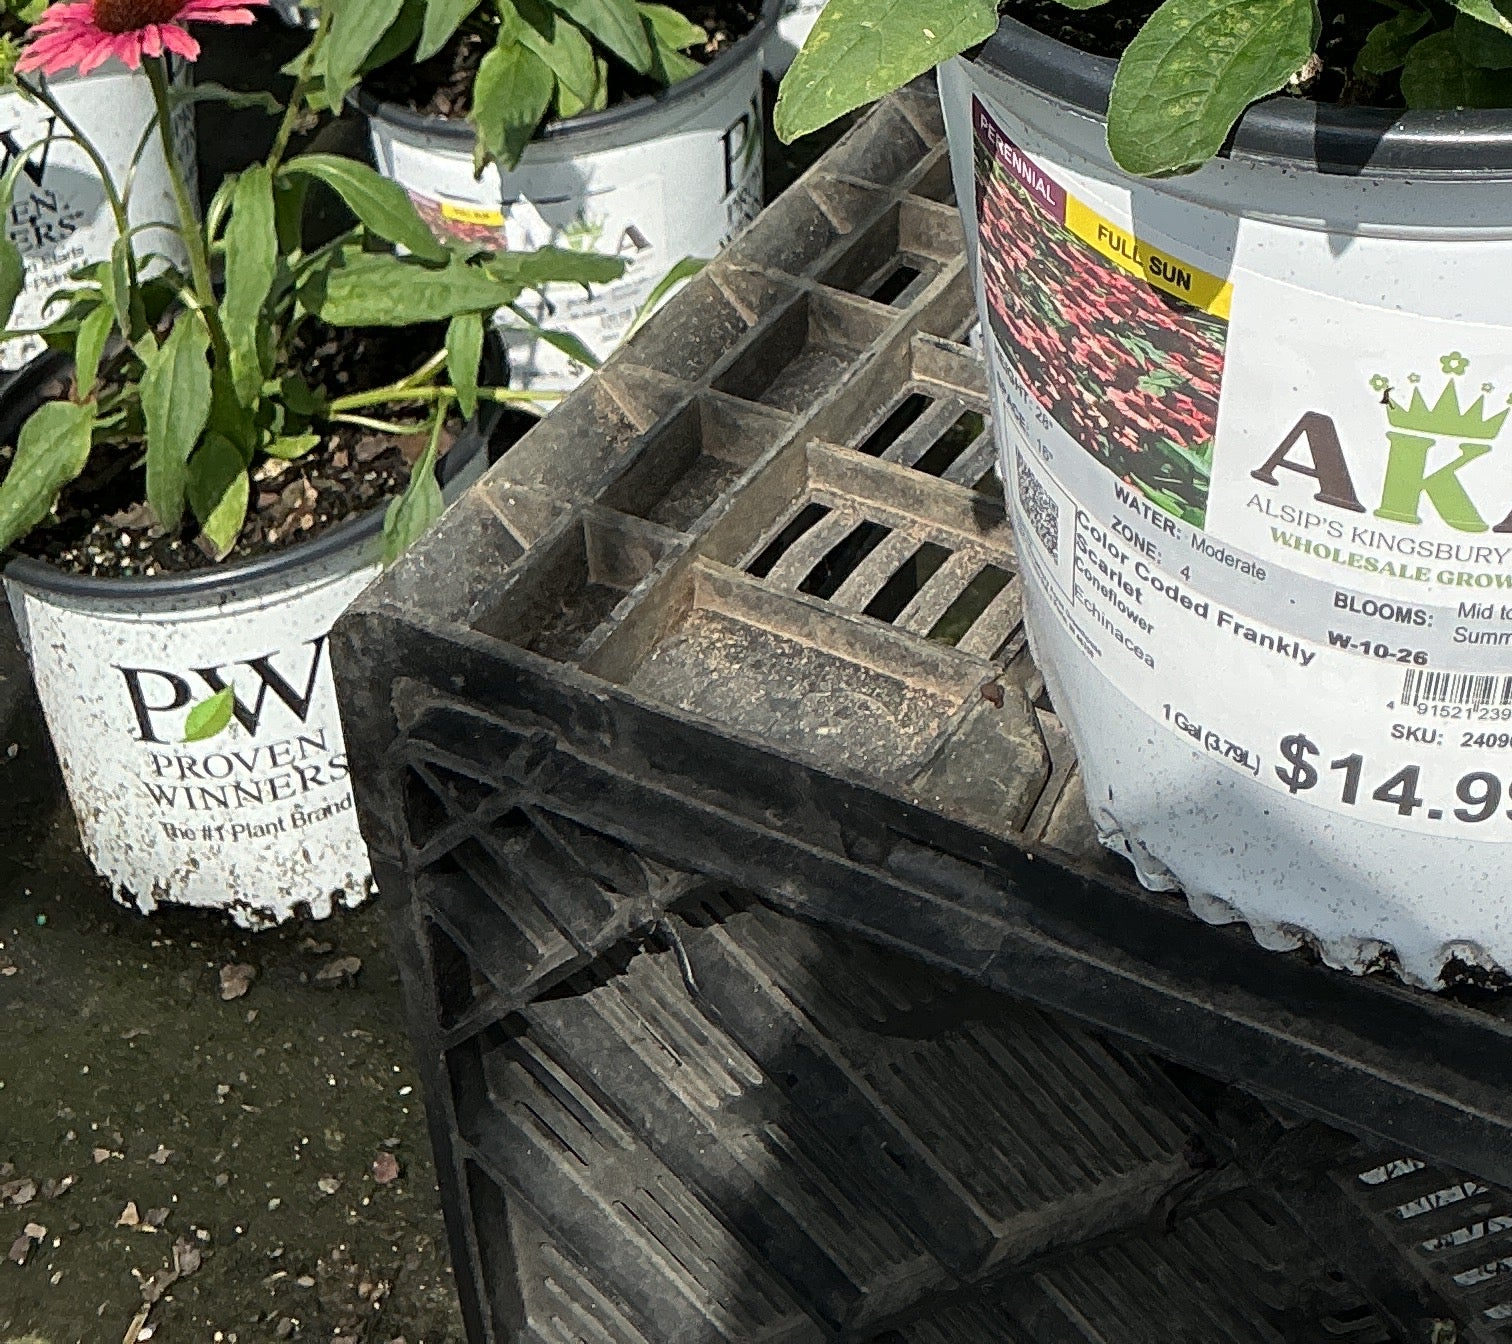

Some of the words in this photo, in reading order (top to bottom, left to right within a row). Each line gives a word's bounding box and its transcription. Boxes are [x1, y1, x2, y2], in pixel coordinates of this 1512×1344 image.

[980, 115, 1056, 206] PERENNIAL
[1097, 223, 1144, 266] FULL
[1149, 255, 1192, 291] SUN
[1111, 514, 1162, 564] ZONE:
[1179, 565, 1191, 582] 4
[1114, 482, 1182, 540] WATER:
[1191, 532, 1267, 582] Moderate
[1246, 493, 1344, 539] ALSIP'S
[1351, 525, 1512, 565] KINGSBURY
[1270, 526, 1430, 583] WHOLESALE
[1075, 555, 1154, 635] Coneflower
[1076, 533, 1143, 604] Scarlet
[1076, 510, 1130, 566] Color
[1134, 560, 1209, 620] Coded
[1216, 609, 1316, 668] Frankly
[1073, 582, 1156, 670] Echinacea
[1333, 591, 1434, 627] BLOOMS:
[1457, 601, 1495, 621] Mid
[1327, 629, 1429, 666] W-10-26
[110, 634, 330, 744] PW
[1162, 703, 1171, 721] 1
[1174, 711, 1202, 742] Gal
[1416, 702, 1473, 720] 91521
[149, 727, 330, 782] PROVEN
[1390, 723, 1444, 746] SKU:
[143, 753, 350, 812] WINNERS
[230, 816, 288, 842] Plant
[291, 792, 353, 830] Brand
